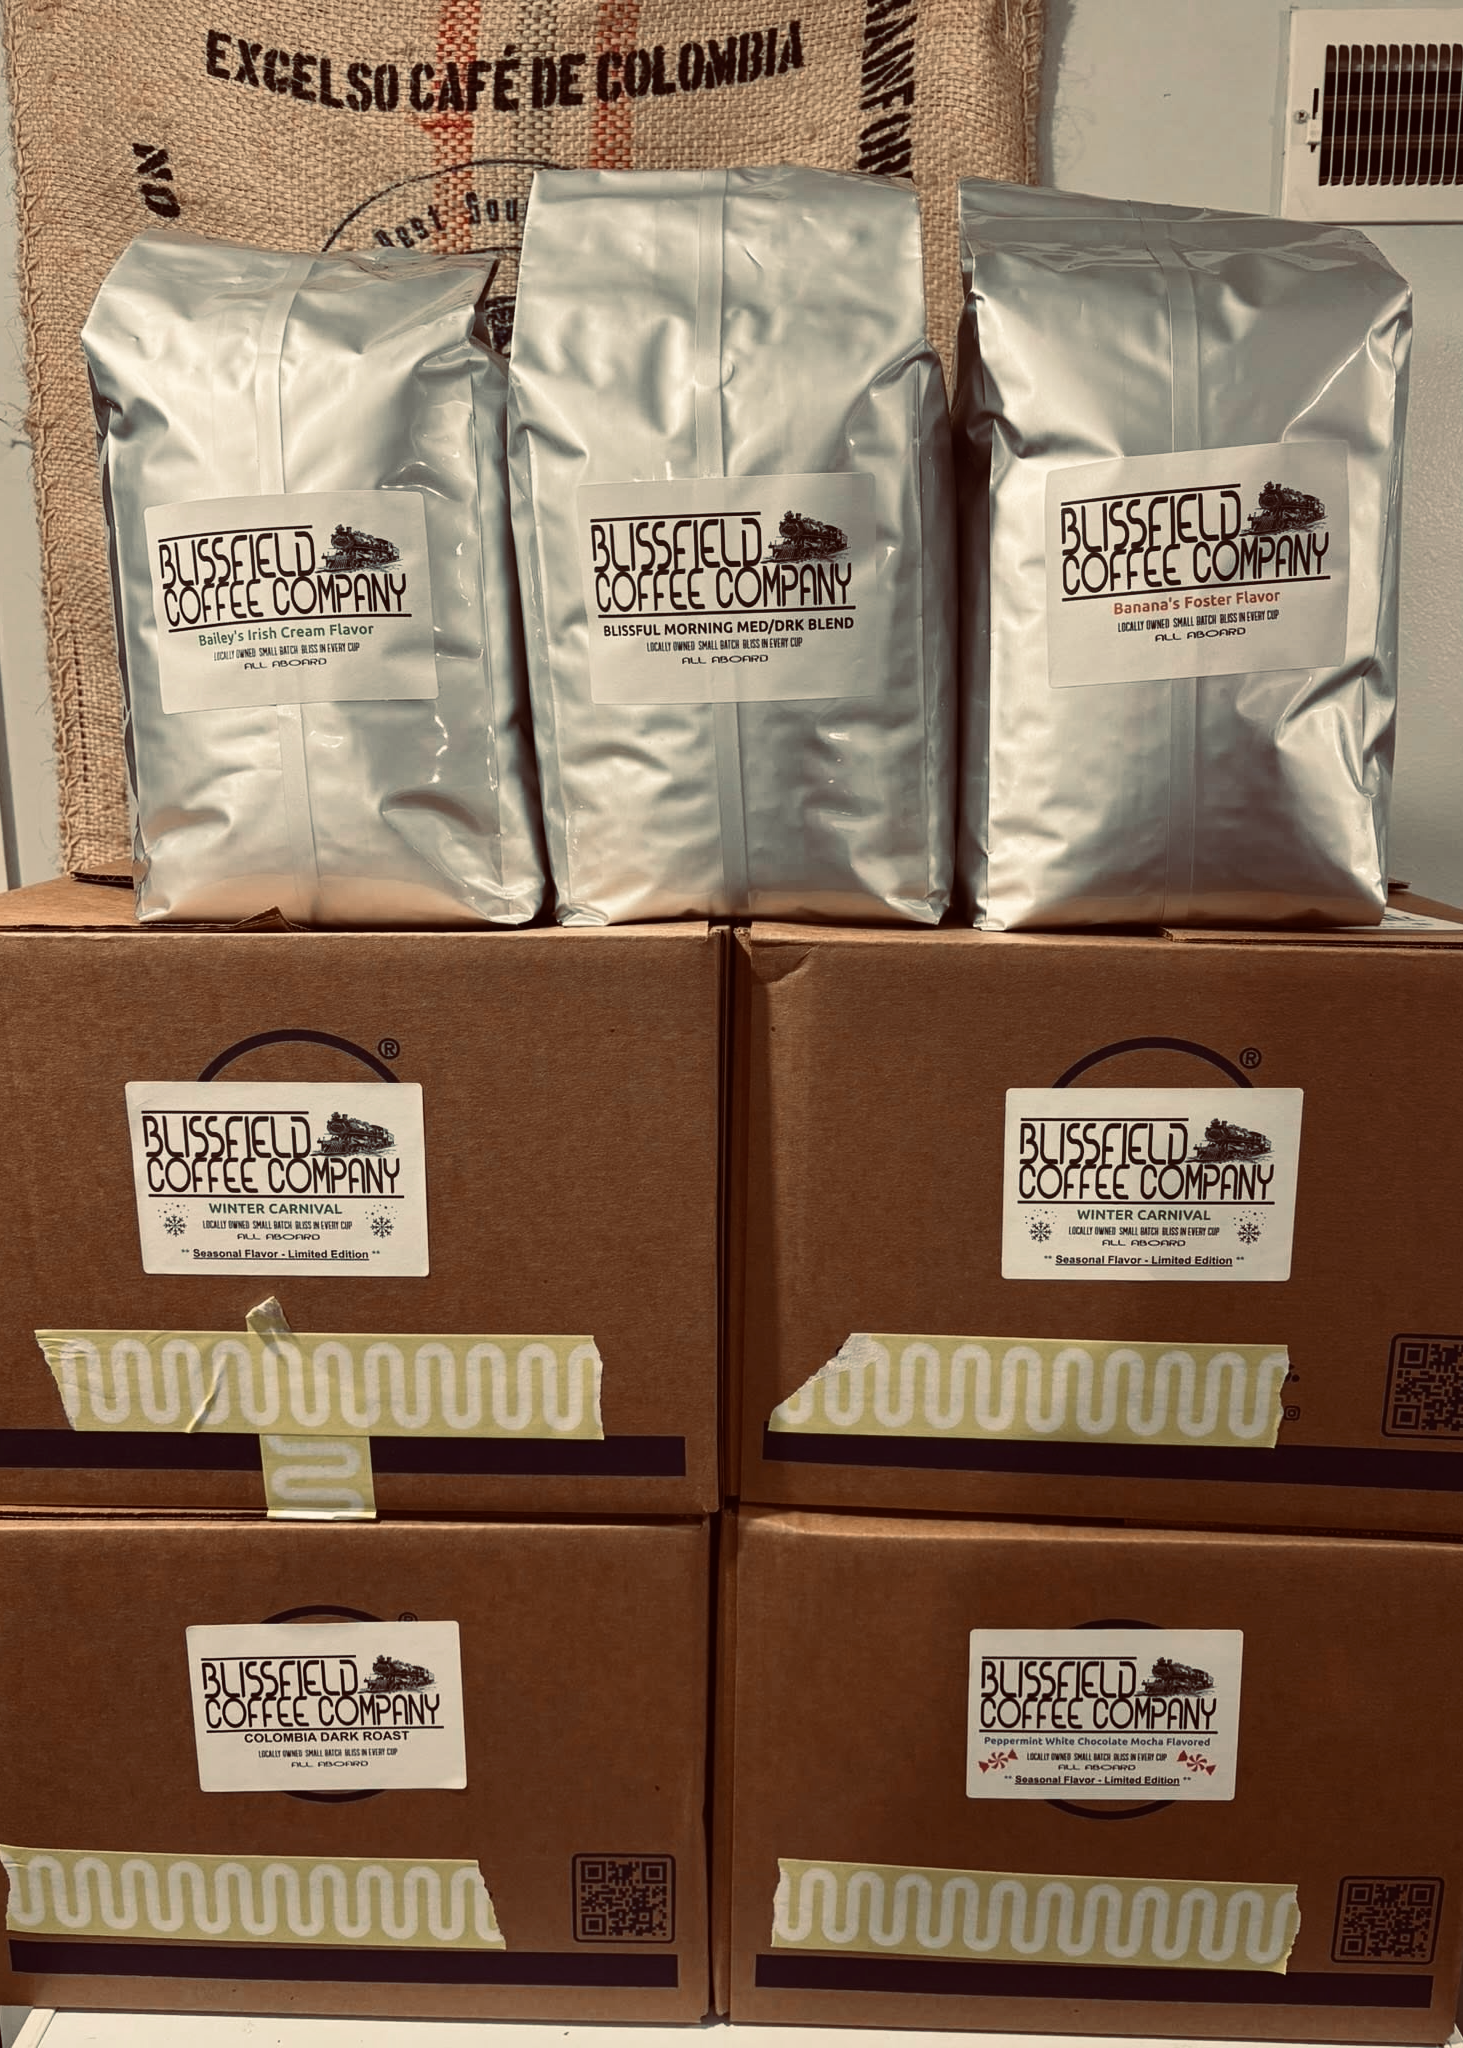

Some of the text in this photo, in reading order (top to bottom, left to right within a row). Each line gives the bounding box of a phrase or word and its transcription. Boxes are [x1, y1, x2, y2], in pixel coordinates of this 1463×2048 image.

[206, 20, 804, 112] EXCELSO CAFÉ DE COLOMBIA
[465, 192, 529, 224] Sou
[1061, 490, 1241, 556] BLISSFIELD
[591, 518, 761, 572] BLISSFIELD
[159, 531, 315, 589] BLISSFIELD
[1062, 532, 1329, 595] COFFEE COMPANY
[596, 562, 851, 612] COFFEE COMPANY
[164, 573, 406, 626] COFFEE COMPANY
[1114, 592, 1280, 615] Banana's Foster Flavor
[603, 617, 854, 637] BLISSFUL MORNING MED/DRK BLEND
[1118, 621, 1144, 632] LOCALLY
[1147, 619, 1170, 630] OWNED
[1173, 617, 1194, 628] SMALL
[1196, 615, 1216, 626] BATCH
[1220, 612, 1237, 624] BLISS
[1247, 610, 1265, 622] EVERY
[1267, 610, 1279, 620] CUP
[199, 623, 374, 646] Bailey's Irish Cream Flavor
[647, 642, 670, 652] LOCALLY
[673, 641, 695, 651] OWNED
[698, 640, 717, 650] SMALL
[720, 640, 739, 650] BATCH
[743, 639, 760, 649] BLISS
[769, 638, 789, 648] EVERY
[790, 638, 802, 648] CUP
[1155, 628, 1246, 642] ALL ABOARD
[214, 650, 234, 661] LOCALLY
[236, 647, 256, 658] OWNED
[259, 646, 278, 657] SMALL
[280, 646, 298, 655] BATCH
[301, 644, 318, 654] BLISS
[328, 643, 346, 652] EVERY
[348, 642, 360, 652] CUP
[711, 654, 768, 663] ABOARD
[244, 658, 327, 670] ALL ABOARD
[142, 1116, 311, 1158] BLISSFIELD
[1020, 1123, 1188, 1164] BLISSFIELD
[147, 1157, 400, 1194] COFFEE COMPANY
[1019, 1164, 1274, 1200] COFFEE COMPANY
[209, 1204, 342, 1214] WINTER CARNIVAL
[1078, 1210, 1211, 1220] WINTER CARNIVAL
[203, 1220, 226, 1230] LOCALLY
[228, 1220, 250, 1230] OWNED
[252, 1220, 271, 1230] SMALL
[274, 1220, 292, 1230] BATCH
[295, 1221, 312, 1230] BLISS
[321, 1221, 339, 1230] EVERY
[340, 1221, 352, 1230] CUP
[1068, 1227, 1092, 1236] LOCALLY
[1095, 1227, 1116, 1236] OWNED
[1119, 1227, 1138, 1236] SMALL
[1140, 1227, 1159, 1236] BATCH
[1162, 1227, 1178, 1236] BLISS
[1188, 1227, 1206, 1236] EVERY
[1207, 1227, 1219, 1236] CUP
[193, 1248, 242, 1259] Seasonal
[244, 1249, 278, 1259] Flavor
[288, 1250, 328, 1259] Limited
[331, 1250, 369, 1260] Edition
[1056, 1255, 1104, 1265] Seasonal
[1108, 1255, 1142, 1265] Flavor
[1152, 1256, 1192, 1265] Limited
[1194, 1256, 1232, 1265] Edition
[202, 1660, 358, 1698] BLISSFIELD
[981, 1661, 1136, 1698] BLISSFIELD
[205, 1693, 440, 1728] COFFEE COMPANY
[980, 1697, 1216, 1729] COFFEE COMPANY
[244, 1731, 409, 1743] COLOMBIA DARK ROAST
[984, 1737, 1210, 1747] Peppermint White Chocolate Mocha Flavored
[258, 1750, 281, 1758] LOCALLY
[283, 1750, 303, 1758] OWNED
[305, 1749, 322, 1757] SMALL
[345, 1749, 360, 1757] BLISS
[368, 1748, 385, 1756] EVERY
[386, 1748, 398, 1756] CUP
[1027, 1752, 1049, 1761] LOCALLY
[1051, 1752, 1071, 1761] OWNED
[1074, 1752, 1091, 1761] SMALL
[1093, 1752, 1110, 1761] BATCH
[1114, 1753, 1129, 1761] BLISS
[1137, 1753, 1154, 1761] EVERY
[1156, 1753, 1167, 1761] CUP
[1015, 1775, 1061, 1784] Seasonal
[1064, 1776, 1095, 1784] Flavor
[1104, 1776, 1142, 1784] Limited
[1145, 1776, 1180, 1785] Edition
